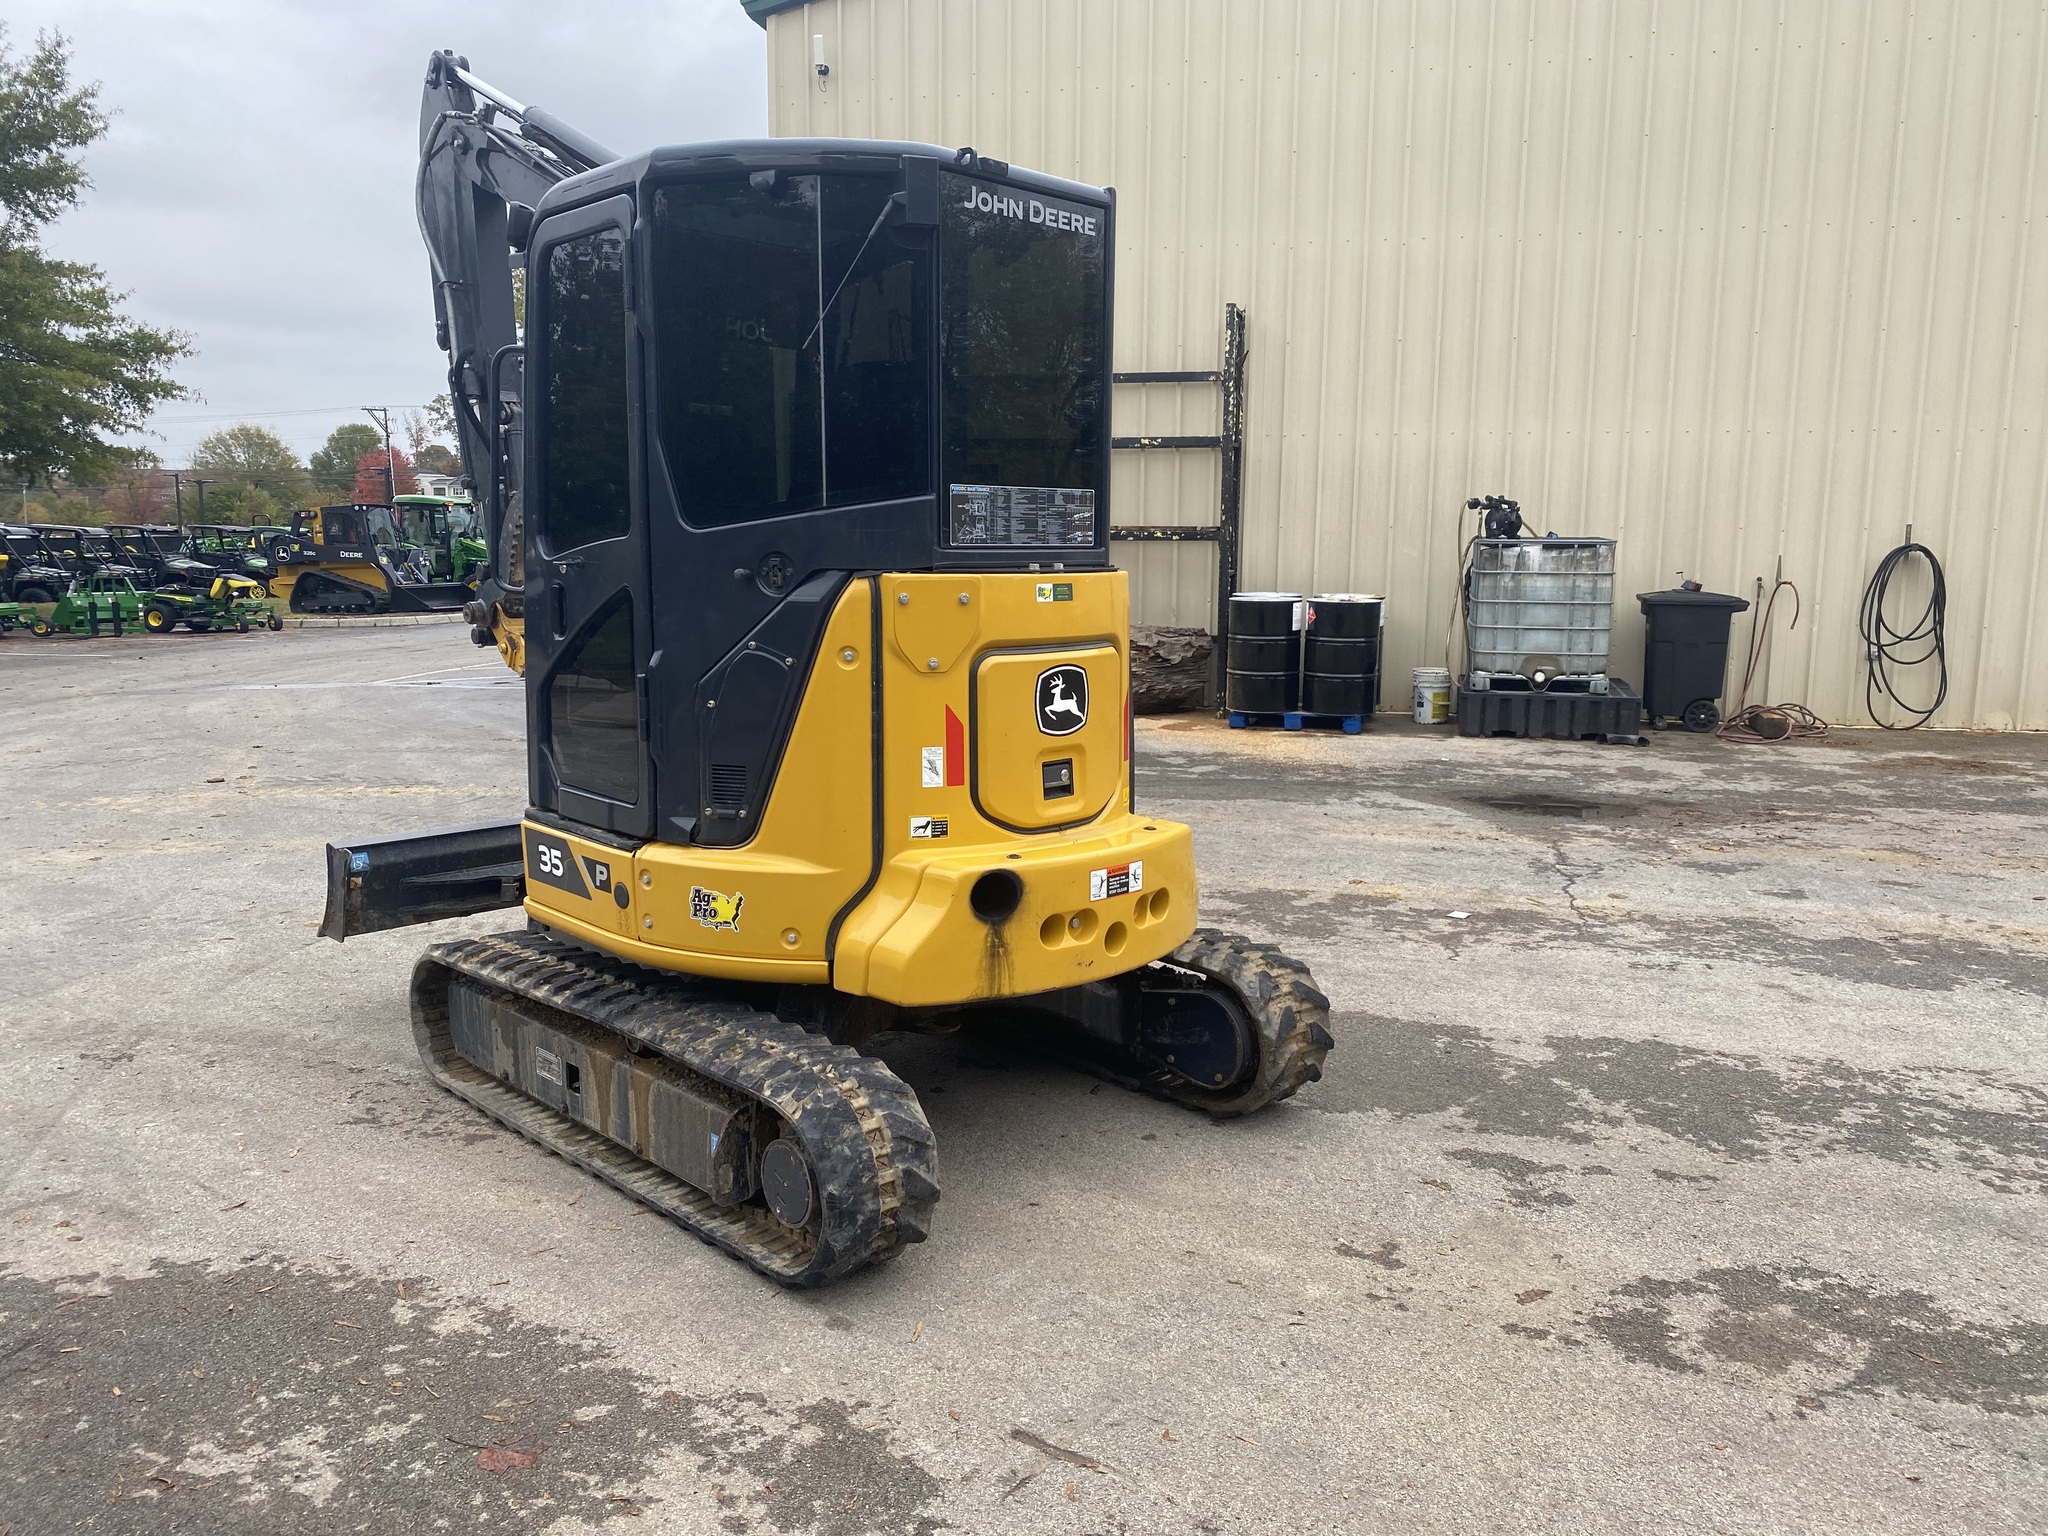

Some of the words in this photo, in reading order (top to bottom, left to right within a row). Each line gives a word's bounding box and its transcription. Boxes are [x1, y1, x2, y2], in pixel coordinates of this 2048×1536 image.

[964, 185, 1023, 220] JOHN
[1029, 199, 1097, 237] DEERE
[538, 844, 564, 877] 35
[595, 864, 608, 886] P
[692, 903, 718, 918] Pro
